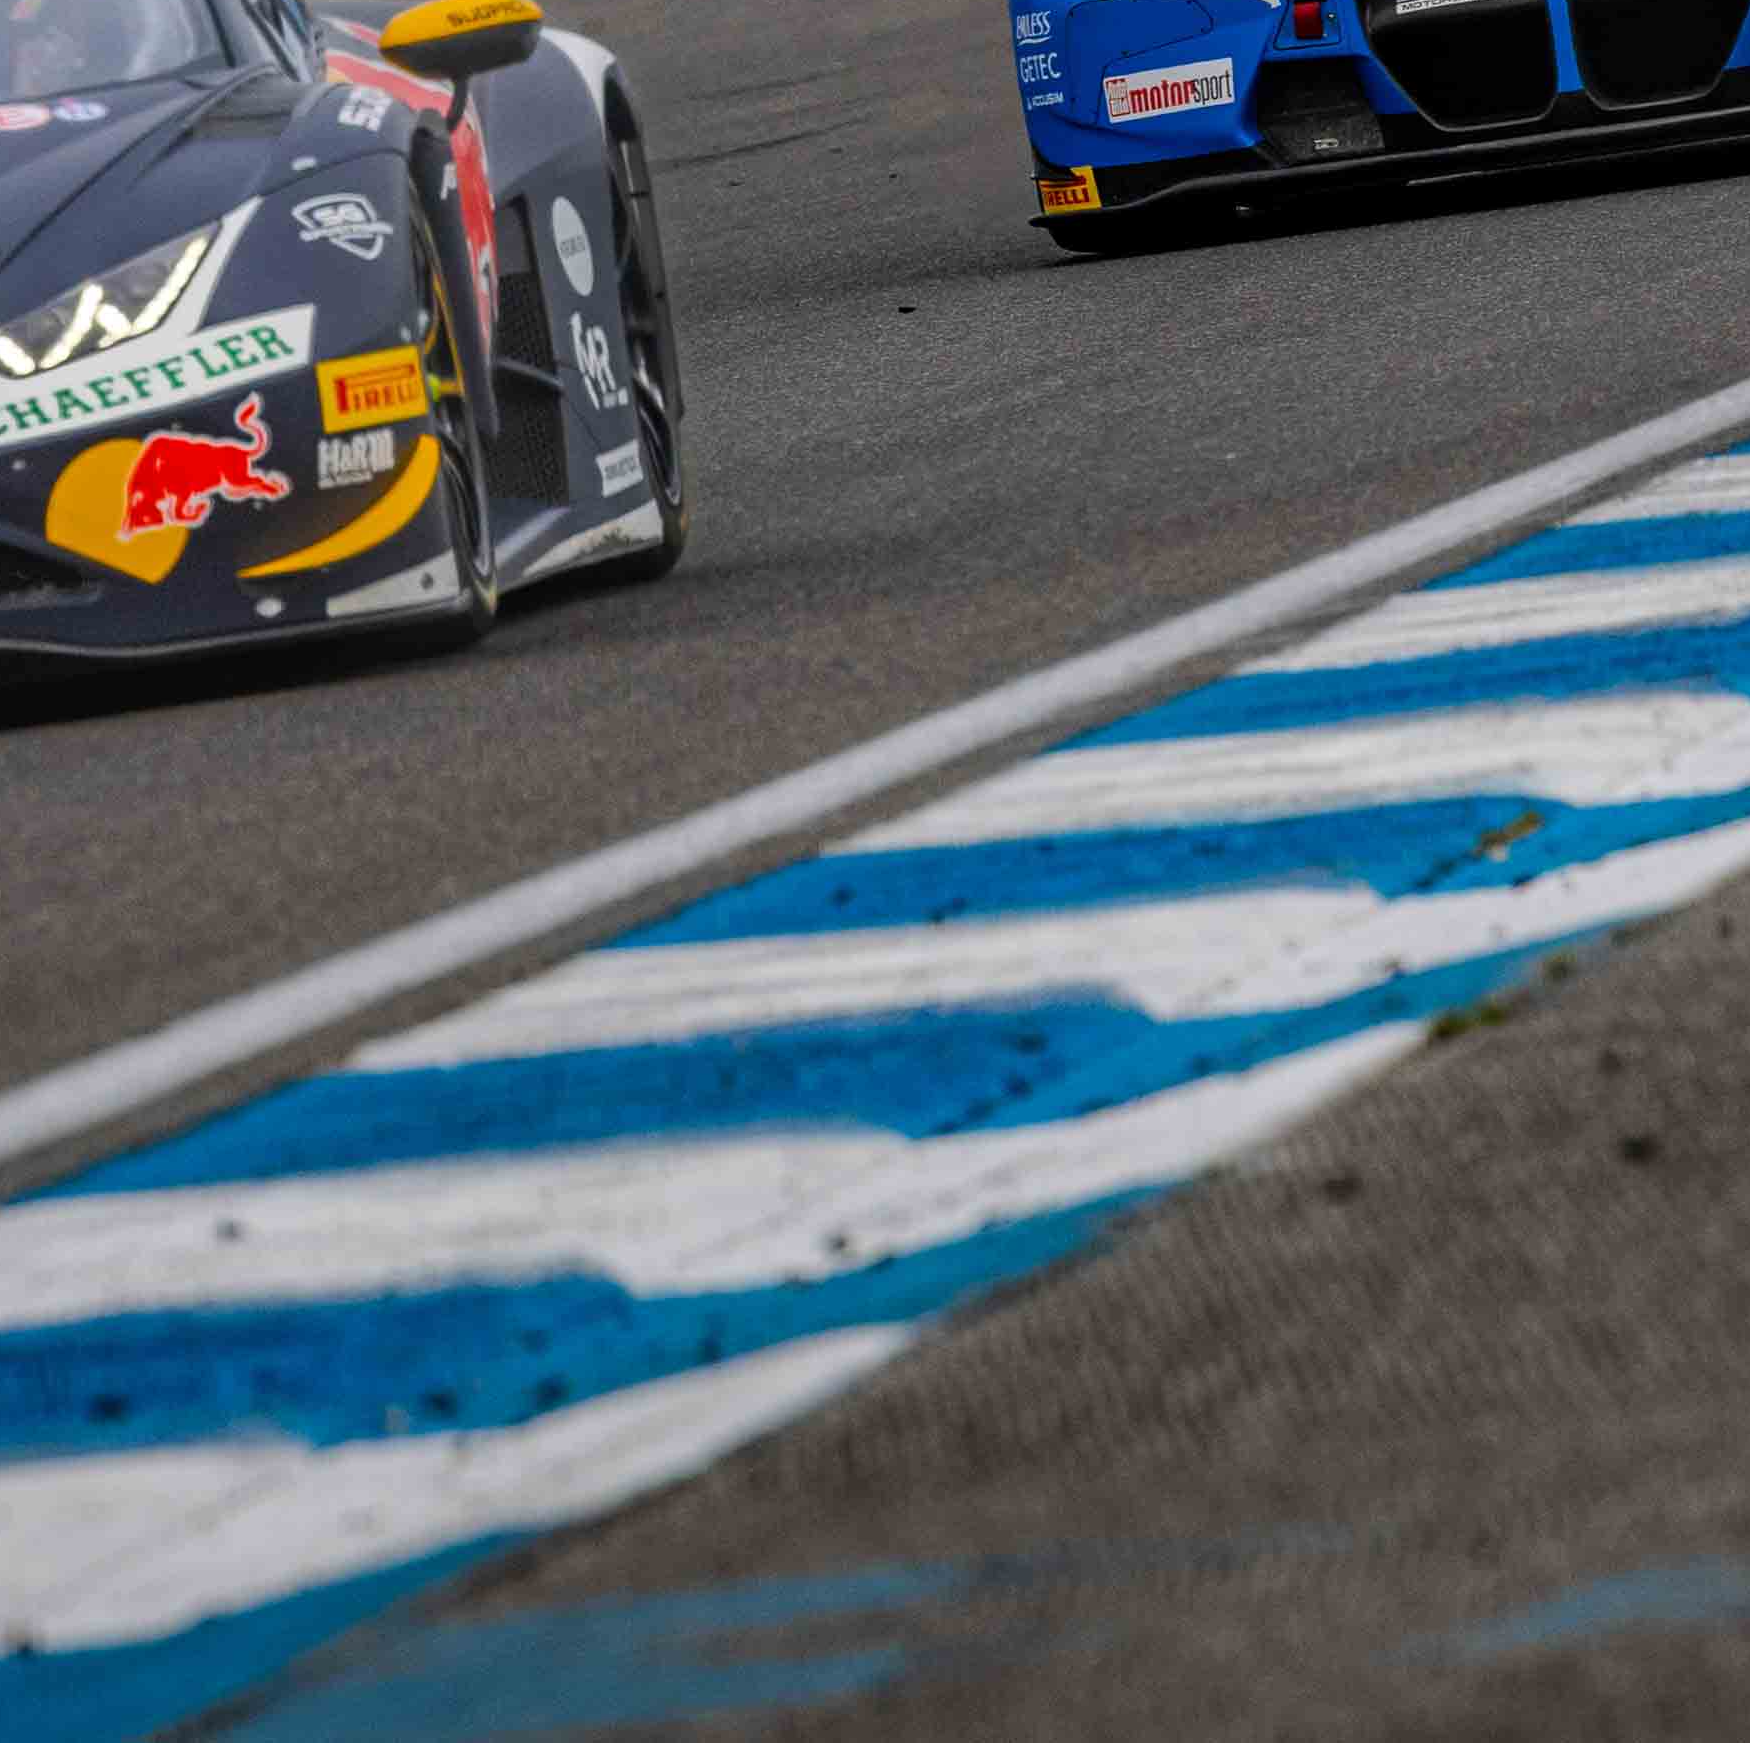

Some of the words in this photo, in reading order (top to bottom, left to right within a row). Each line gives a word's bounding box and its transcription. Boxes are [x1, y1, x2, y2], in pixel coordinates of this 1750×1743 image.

[1019, 52, 1061, 83] GETEC
[1128, 68, 1233, 115] motorsport
[334, 364, 420, 416] PIRELLI
